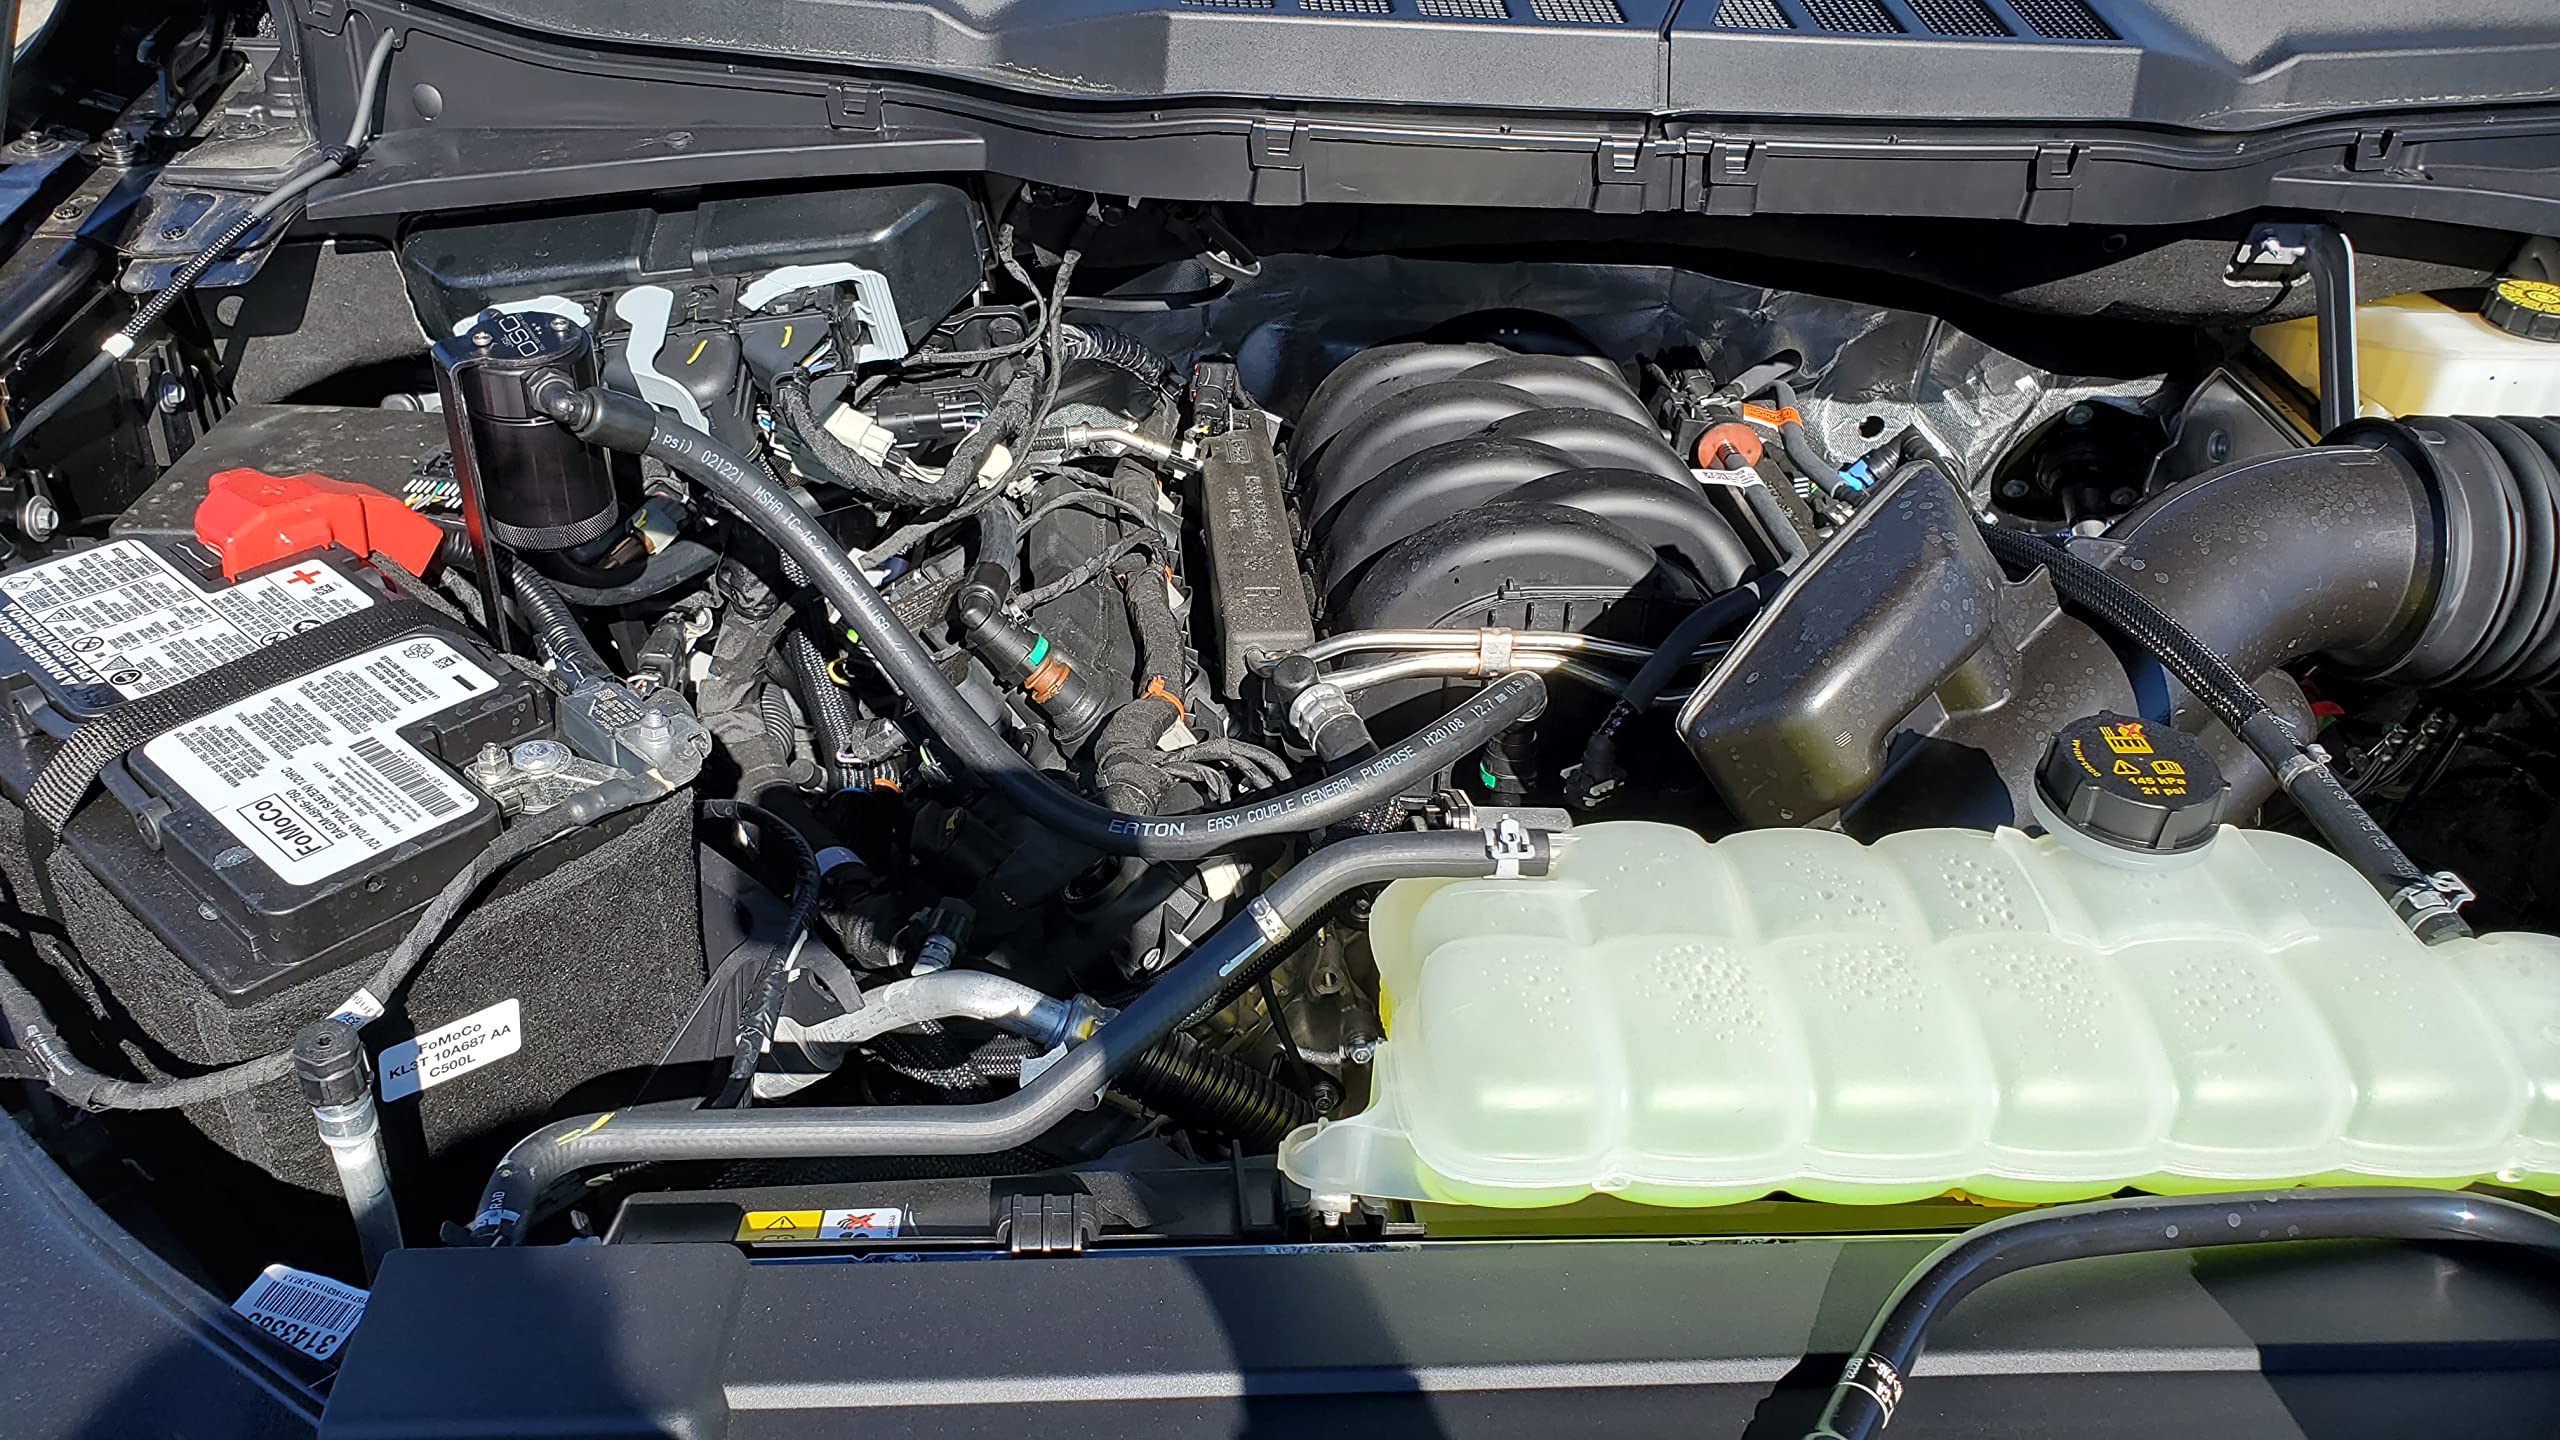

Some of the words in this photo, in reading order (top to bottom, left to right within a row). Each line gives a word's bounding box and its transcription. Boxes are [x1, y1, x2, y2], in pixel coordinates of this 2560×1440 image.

[498, 313, 539, 358] OSC
[662, 433, 693, 455] psi)
[701, 450, 745, 484] 021221
[752, 485, 784, 516] MSHA
[832, 561, 859, 597] MADE
[1108, 818, 1186, 837] EATON
[1207, 812, 1240, 833] EASY
[1246, 795, 1295, 823] COUPLE
[1301, 775, 1357, 807] GENERAL
[1360, 746, 1417, 782] PURPOSE
[1423, 718, 1465, 747] H20108
[1470, 699, 1495, 718] 12.7
[2128, 777, 2156, 785] 145
[2158, 777, 2187, 785] kPa
[300, 783, 337, 810] (SAE/EN)
[2163, 788, 2187, 796] psi
[247, 798, 322, 856] FoMoCo
[284, 788, 348, 839] BAGM-48H6-760
[329, 807, 353, 824] 720A
[345, 822, 370, 839] 70Ah
[363, 837, 383, 850] 12V
[418, 1022, 482, 1054] FoMoCo
[388, 1055, 430, 1081] KL3T
[433, 1034, 487, 1063] 10A687
[490, 1025, 511, 1039] AA
[429, 1053, 476, 1078] C500L
